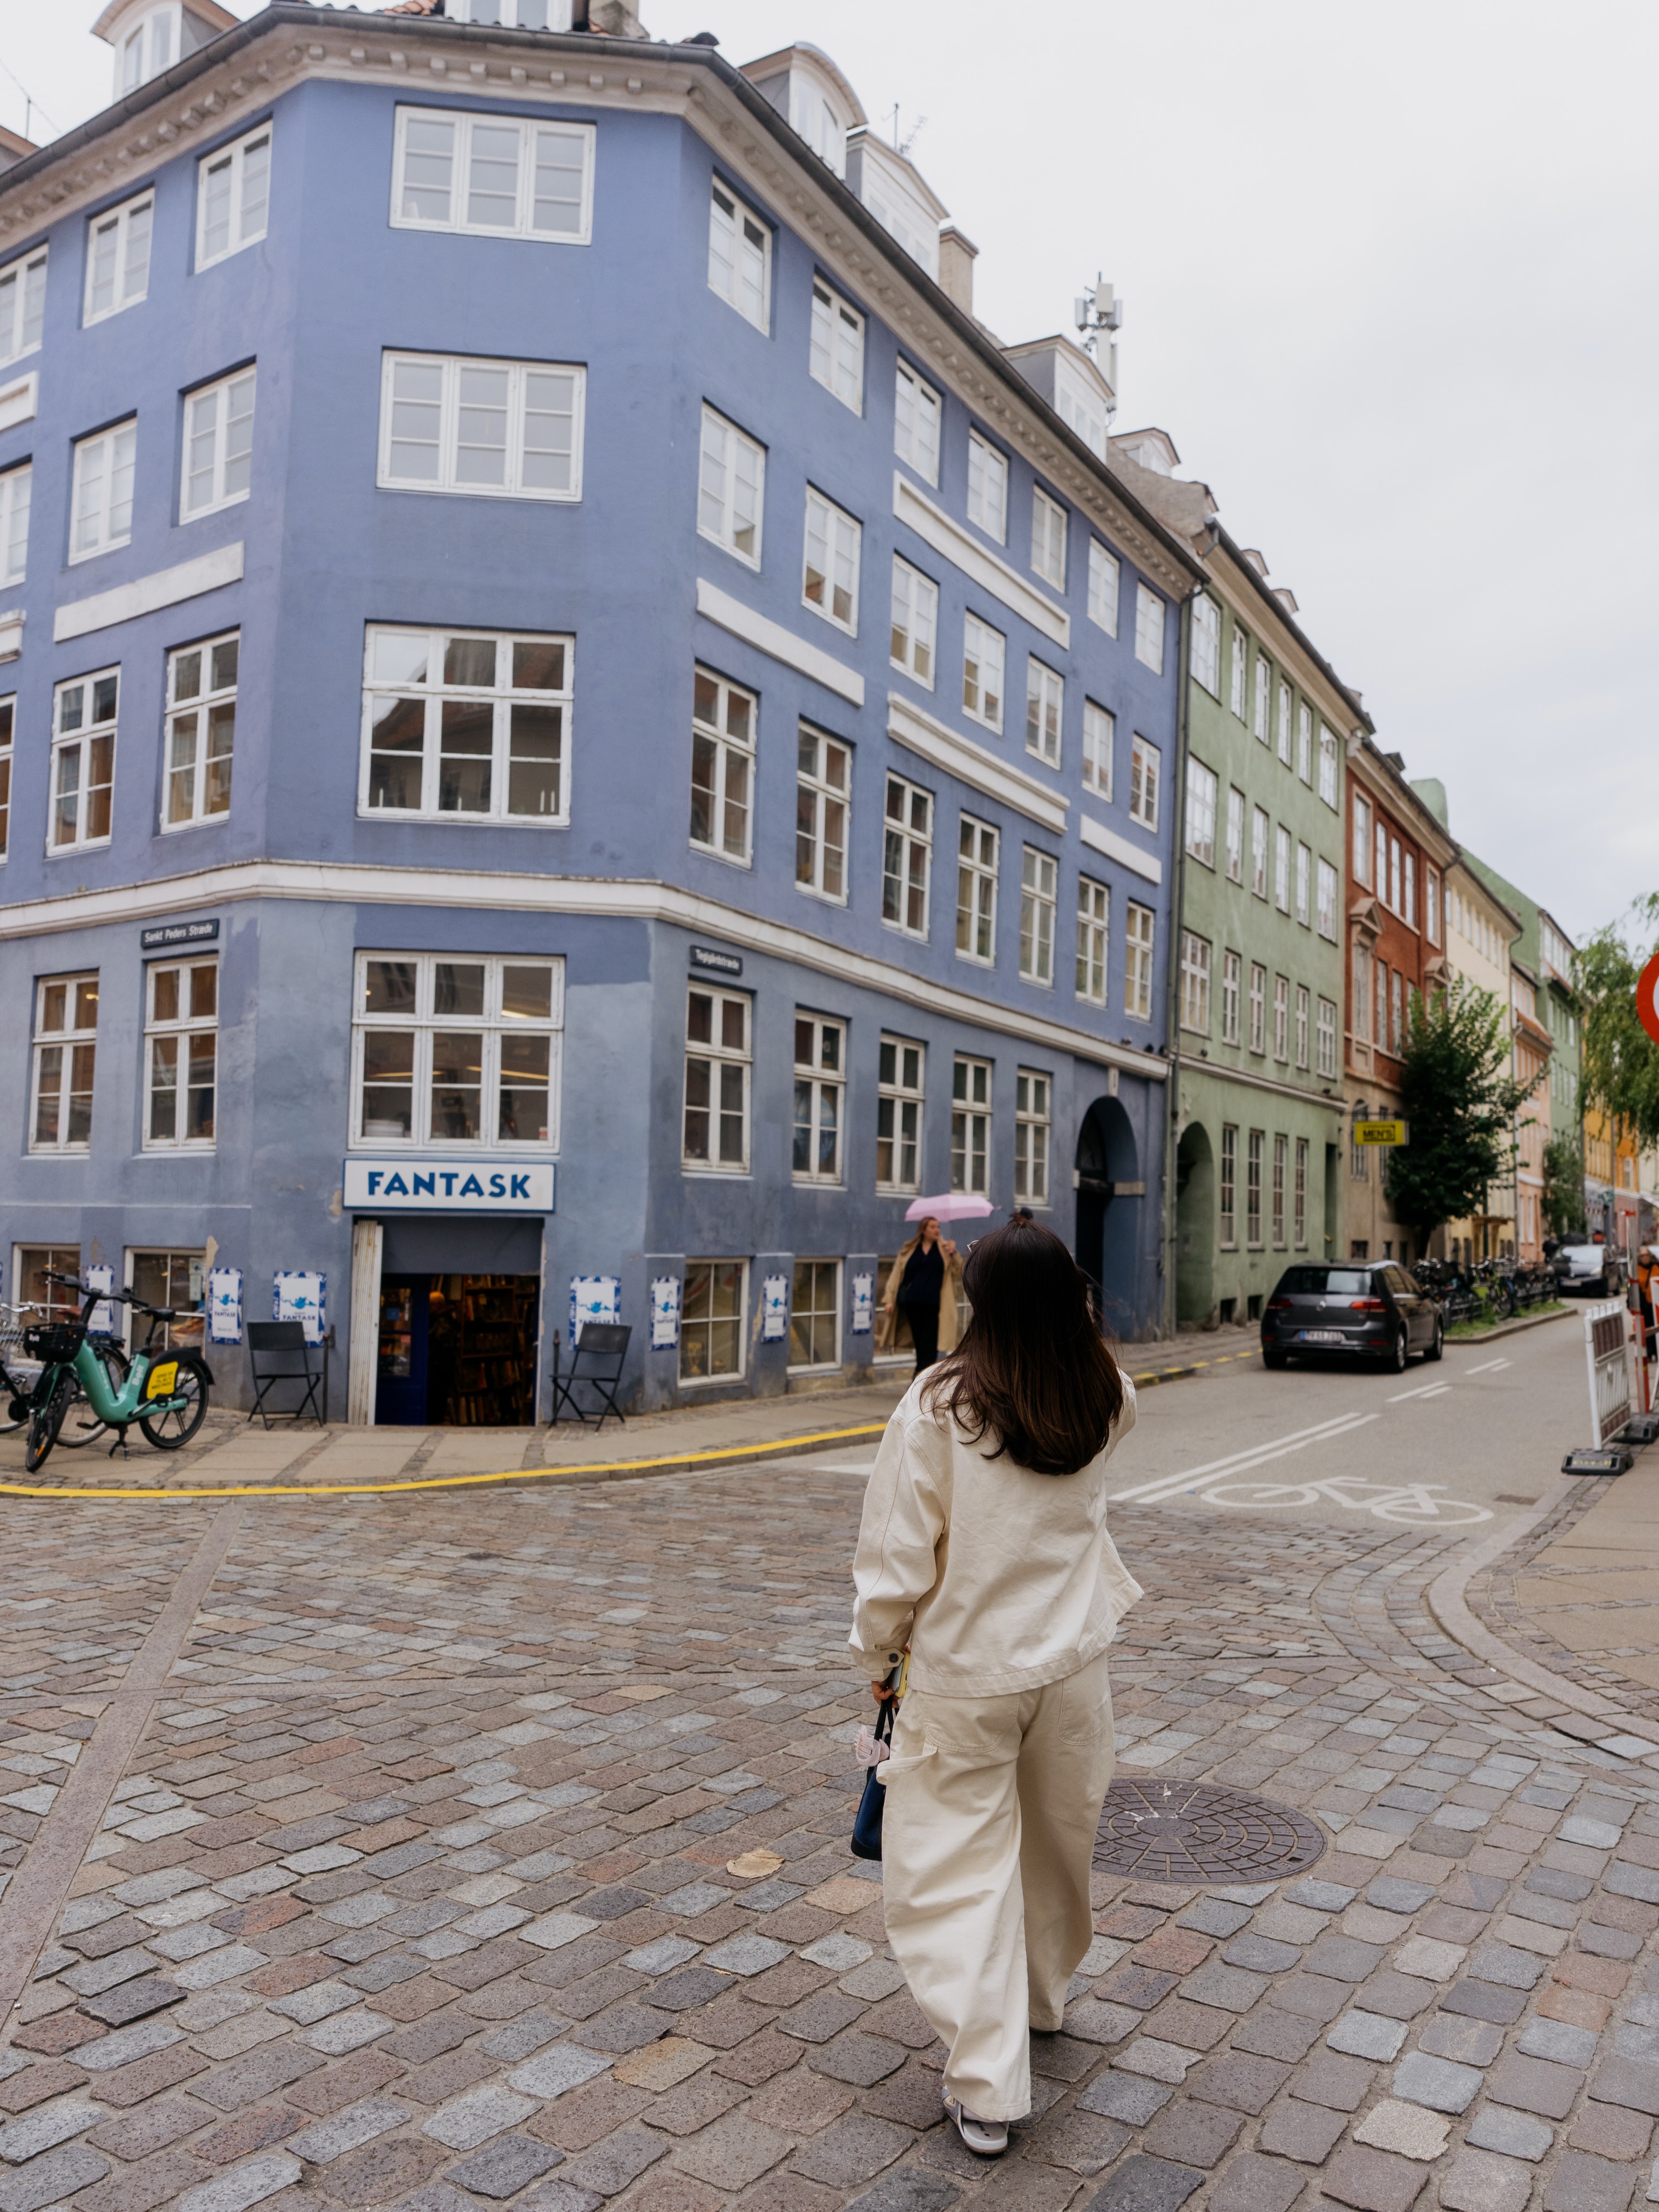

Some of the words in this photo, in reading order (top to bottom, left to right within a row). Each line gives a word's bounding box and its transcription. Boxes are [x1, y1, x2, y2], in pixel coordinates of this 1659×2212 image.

[144, 931, 163, 943] Sankt
[165, 928, 186, 940] Peders
[189, 923, 213, 936] Stræde
[368, 1171, 531, 1199] FANTASK
[29, 1333, 41, 1343] Bolt
[131, 1364, 144, 1386] Bolt
